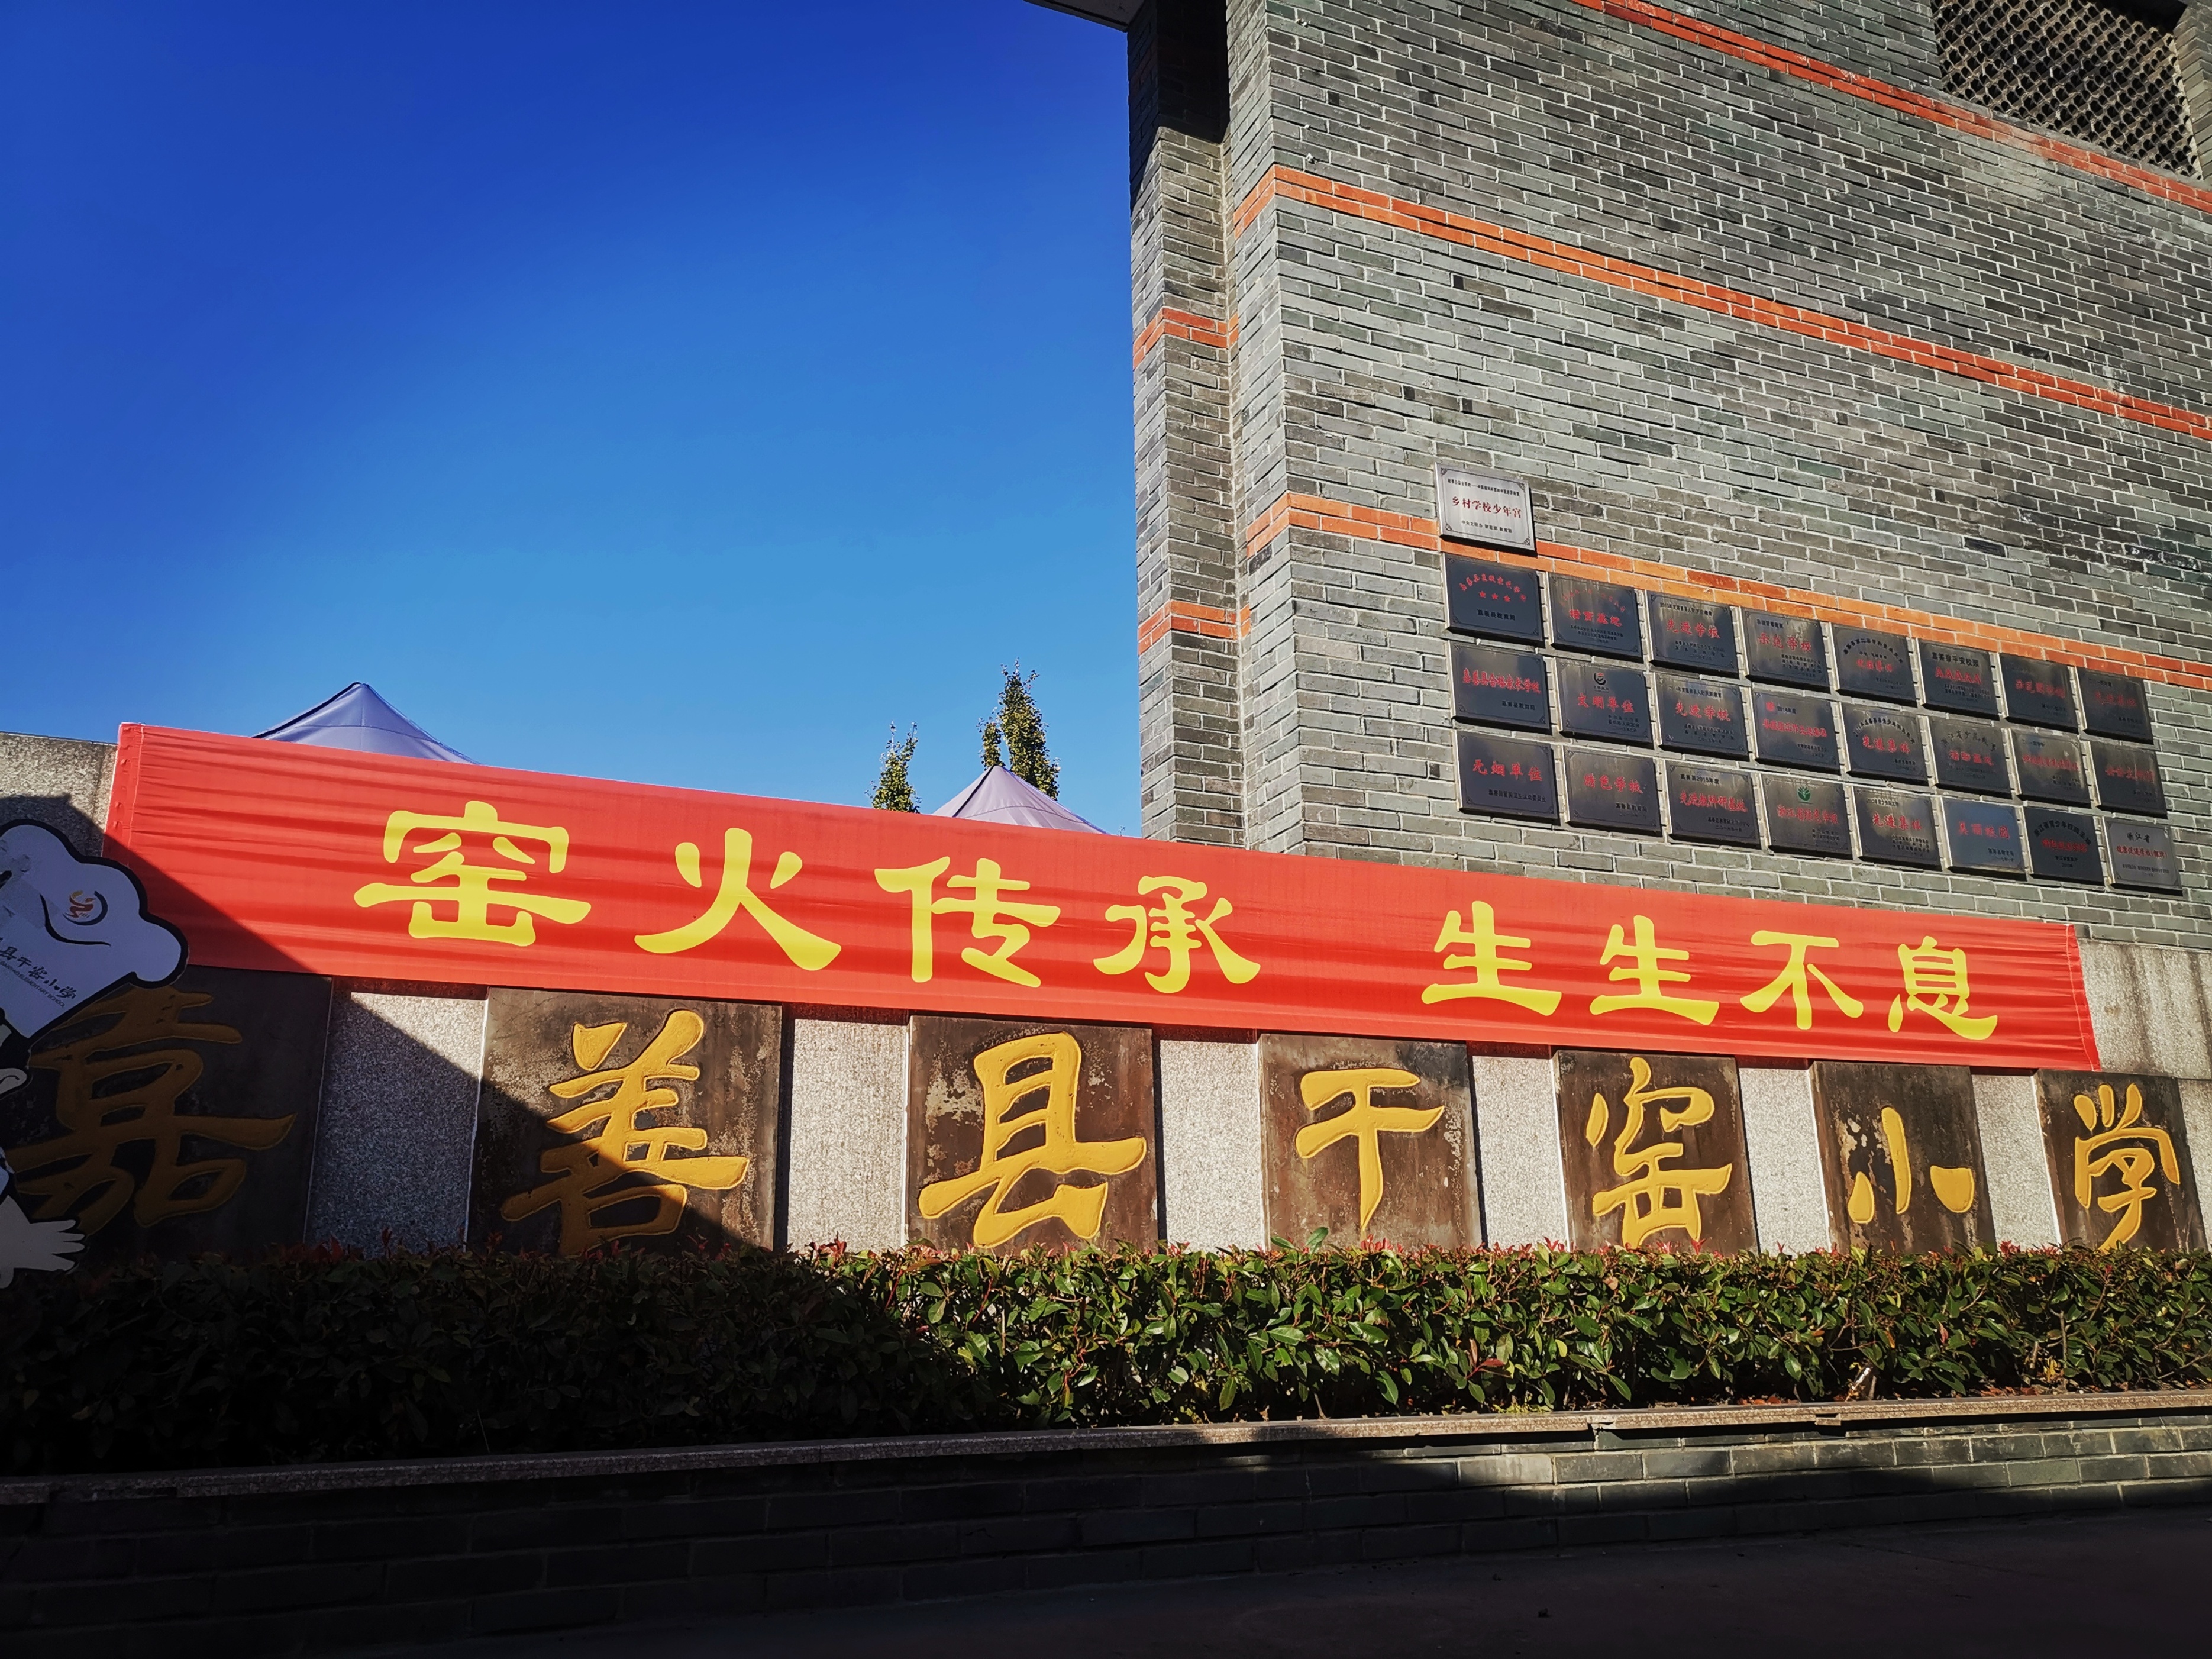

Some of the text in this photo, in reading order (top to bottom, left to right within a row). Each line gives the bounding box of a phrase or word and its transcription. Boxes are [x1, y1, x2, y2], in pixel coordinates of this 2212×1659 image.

[1452, 496, 1522, 518] 乡村学校少年宫
[1667, 618, 1720, 639] 先进学校
[1758, 631, 1811, 653] 示范学校
[1462, 667, 1542, 695] 嘉善县合格家长学校
[1935, 666, 1982, 685] AAAAA
[1577, 692, 1635, 714] 文明单位
[1675, 699, 1731, 722] 先进学校
[1472, 759, 1543, 782] 无烟单位
[1584, 773, 1643, 794] 特色学校
[1680, 789, 1748, 813] 先进教科研基地
[1872, 811, 1922, 831] 先进集体
[1959, 821, 2010, 840] 美丽校园
[2127, 832, 2150, 844] 浙江省
[354, 800, 1999, 1041] 窑火传承 生生不息
[0, 937, 77, 999] 县干窑小学
